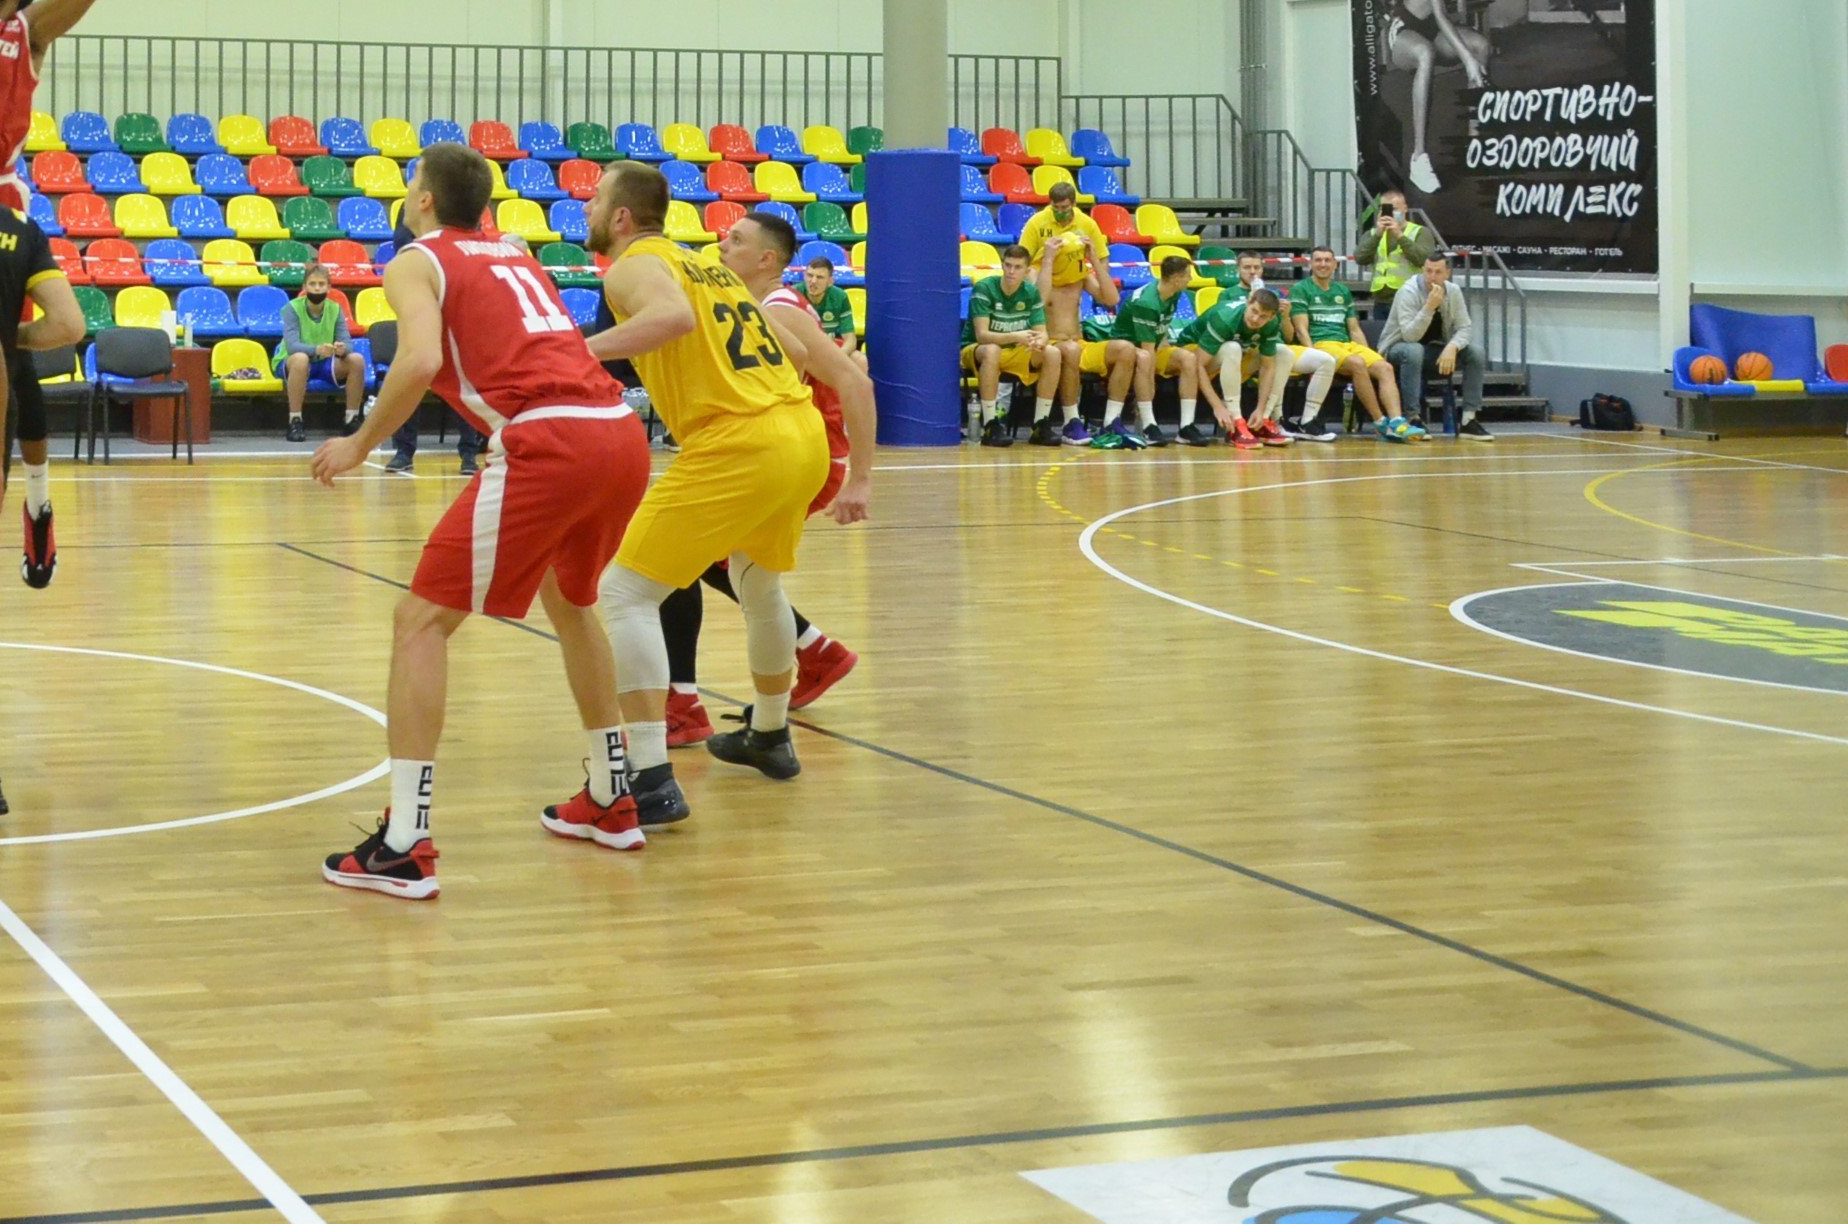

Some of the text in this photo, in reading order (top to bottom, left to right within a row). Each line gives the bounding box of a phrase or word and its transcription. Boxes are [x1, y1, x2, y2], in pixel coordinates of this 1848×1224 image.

[1478, 81, 1654, 124] СПОРТИВНО-
[1466, 128, 1639, 171] ОЗДОРОВЧИЙ
[1496, 181, 1643, 223] КОМПЛЕКС
[1517, 245, 1542, 254] САУНА
[1549, 247, 1587, 256] РЕСТОРАН
[1594, 248, 1624, 257] ГОТЕЛЬ
[490, 265, 575, 333] 11
[713, 301, 783, 371] 23
